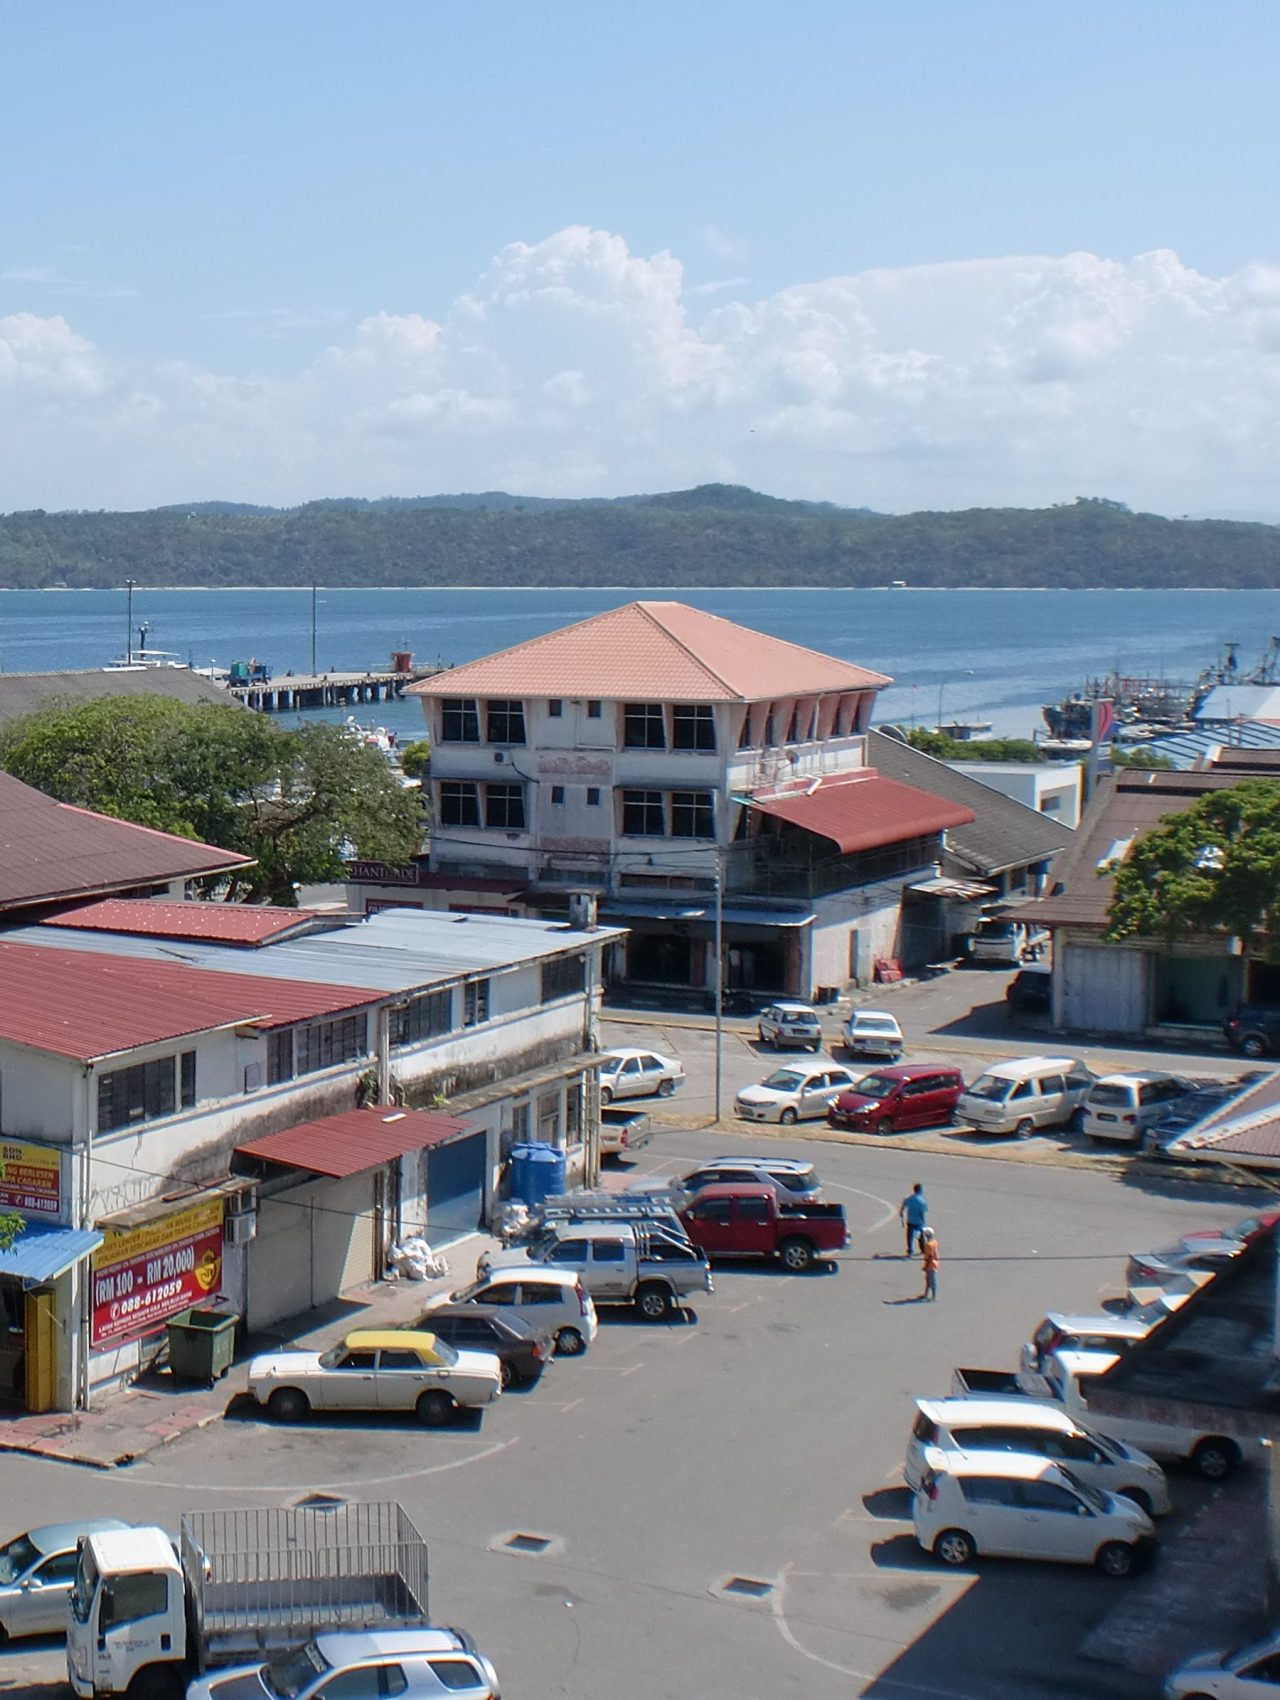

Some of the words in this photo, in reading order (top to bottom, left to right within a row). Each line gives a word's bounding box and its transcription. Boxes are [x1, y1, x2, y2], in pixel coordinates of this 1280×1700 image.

[95, 1275, 114, 1307] (RM
[116, 1269, 133, 1297] 100
[146, 1257, 161, 1285] RM
[162, 1244, 194, 1282] 20,000)
[121, 1278, 182, 1315] 088-612059
